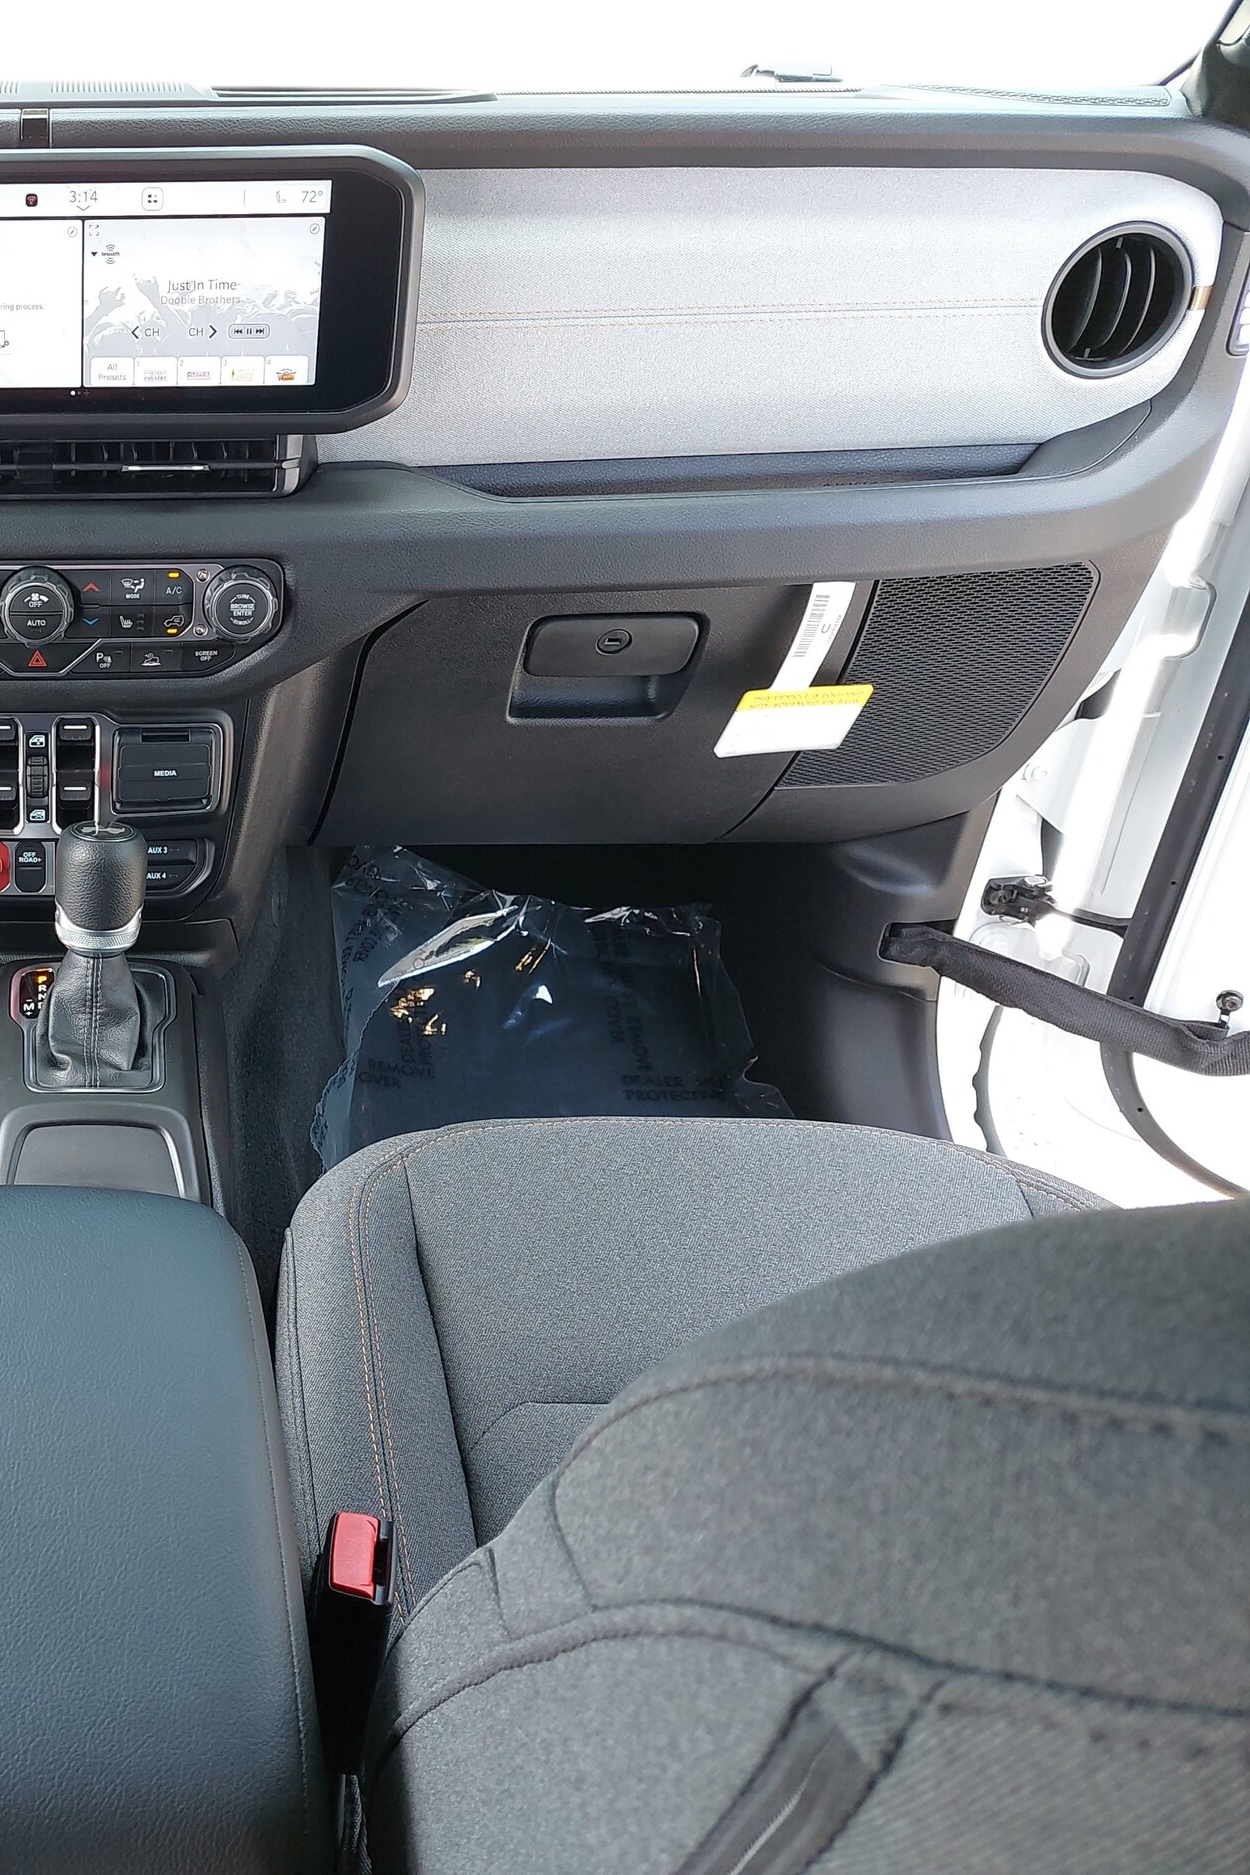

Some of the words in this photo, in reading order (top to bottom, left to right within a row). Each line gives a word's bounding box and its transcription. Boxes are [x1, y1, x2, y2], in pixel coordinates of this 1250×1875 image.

[69, 190, 98, 203] 3:14
[167, 280, 190, 294] Just
[208, 279, 237, 291] Time
[199, 294, 241, 305] Brothers
[144, 328, 160, 337] CH
[188, 328, 204, 337] CH
[107, 363, 117, 371] All
[179, 359, 184, 367] 2
[98, 373, 127, 382] Presets
[166, 586, 182, 595] A/C
[28, 600, 43, 608] OFF
[27, 619, 47, 627] AUTO
[147, 846, 162, 854] AUX
[162, 846, 168, 854] 3
[146, 872, 161, 880] AUX
[161, 872, 167, 880] 4
[37, 975, 48, 984] P
[37, 984, 47, 992] R
[37, 992, 47, 1001] N
[23, 1002, 35, 1011] M
[359, 1072, 401, 1089] OVER
